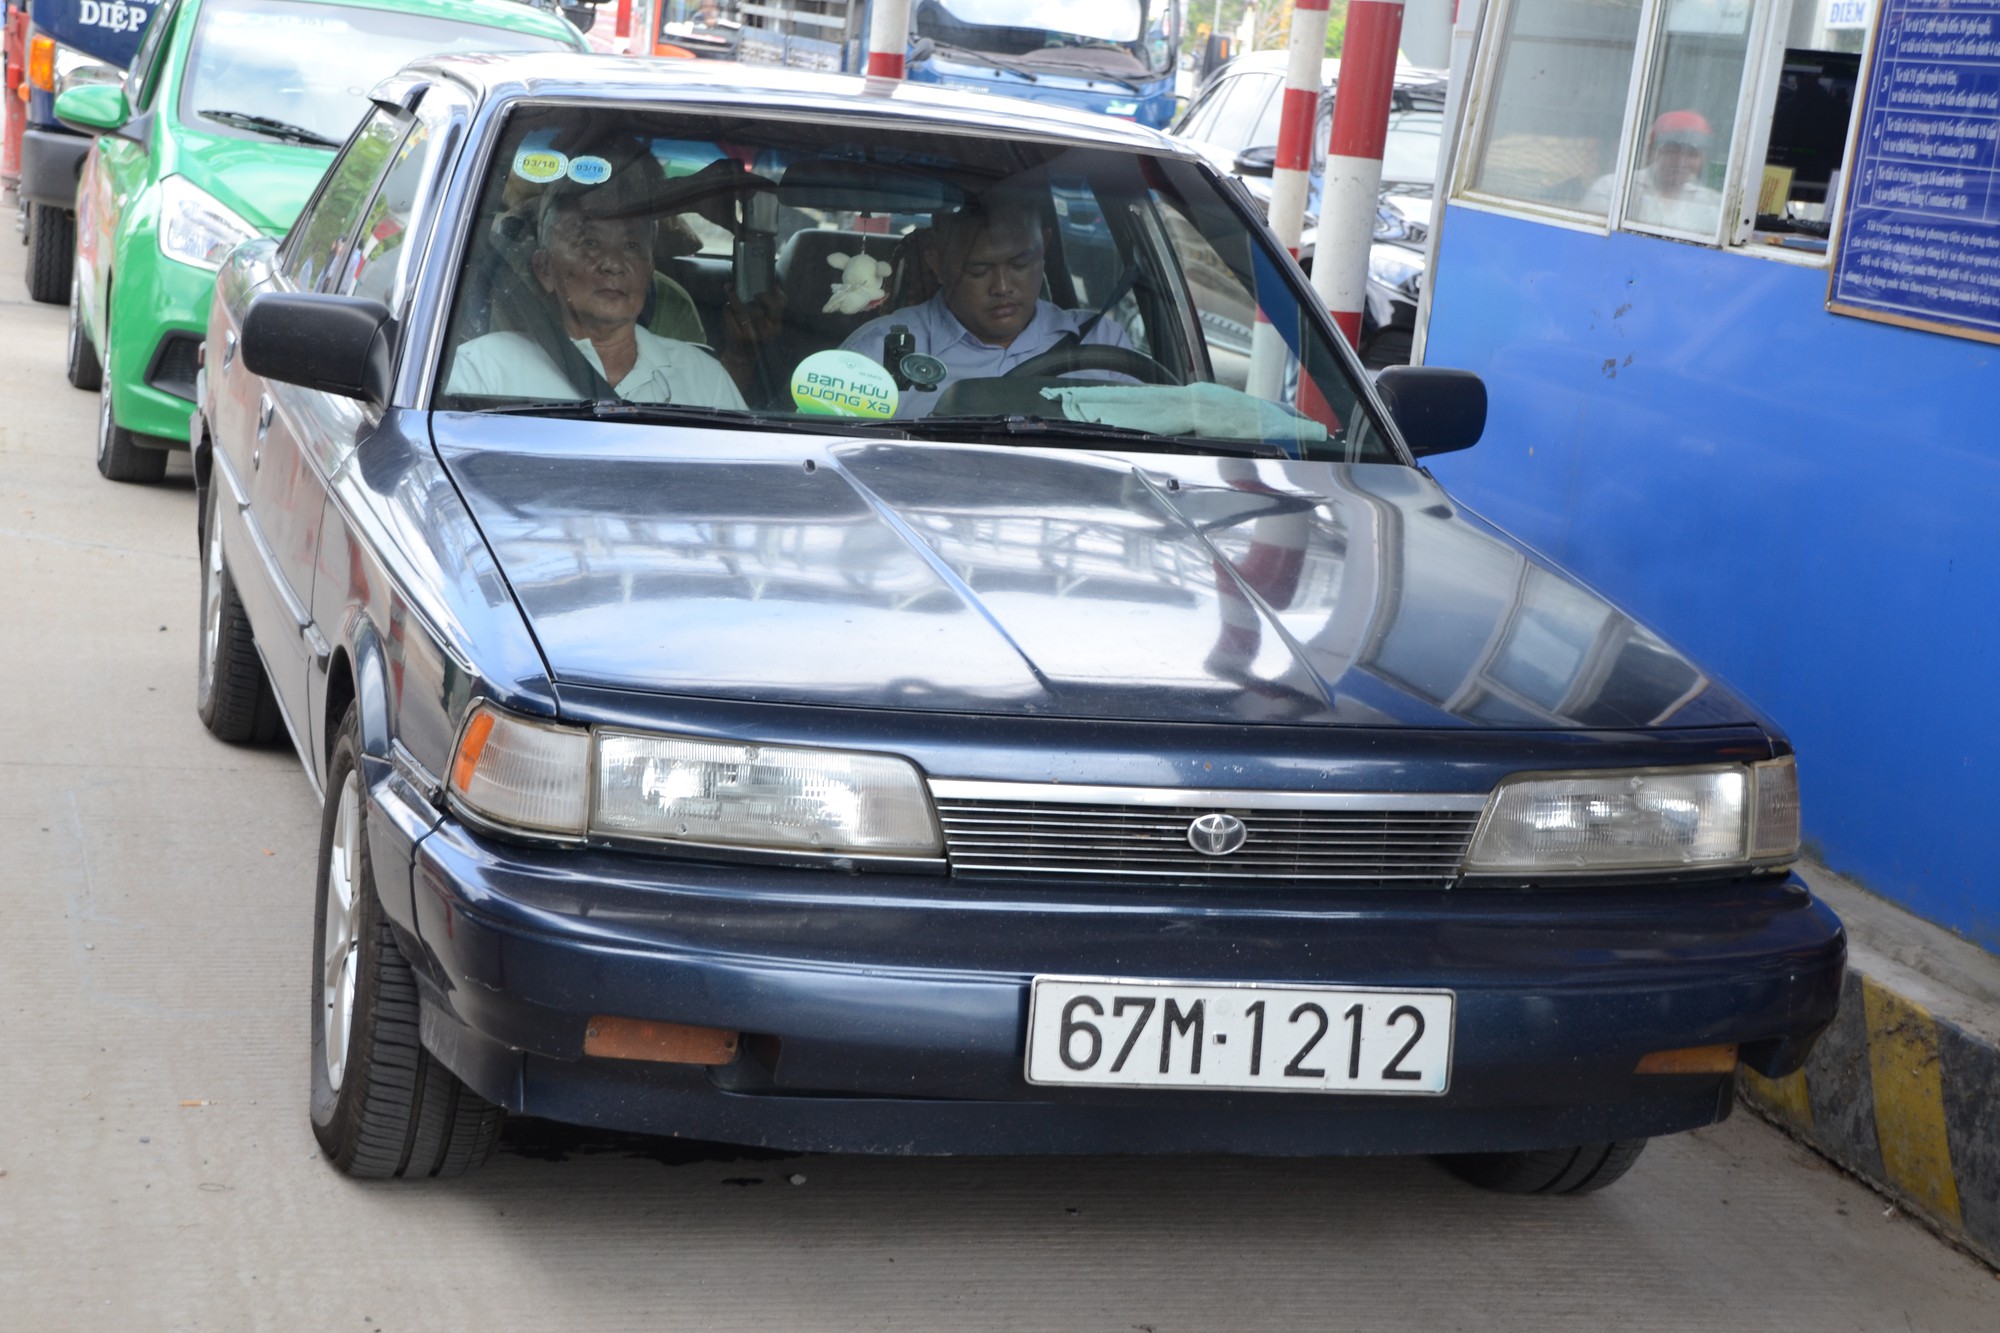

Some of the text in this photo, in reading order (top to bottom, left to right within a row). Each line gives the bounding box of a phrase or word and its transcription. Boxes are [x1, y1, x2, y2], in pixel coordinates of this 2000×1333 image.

[79, 0, 147, 33] DIỆP
[1889, 28, 1898, 45] 2
[1881, 75, 1889, 93] 3
[1873, 123, 1880, 139] 4
[524, 159, 556, 169] 03/18
[576, 165, 604, 173] 03/18
[1864, 169, 1873, 186] 5
[1058, 994, 1426, 1081] 67M-1212
